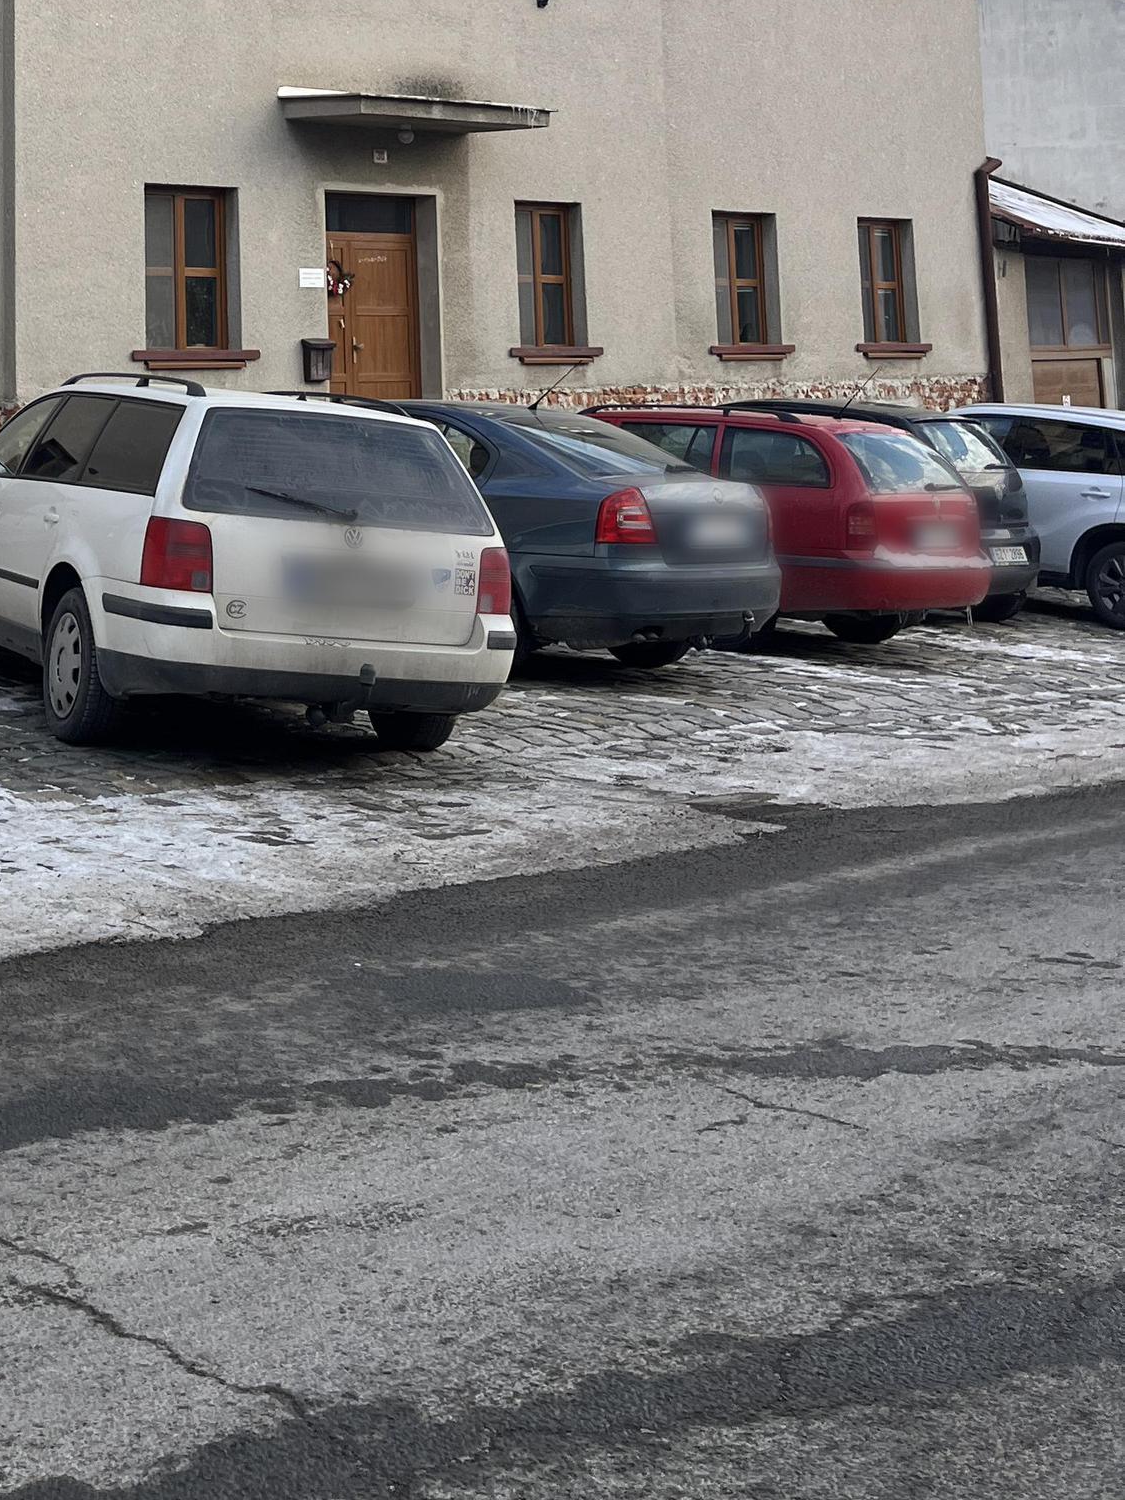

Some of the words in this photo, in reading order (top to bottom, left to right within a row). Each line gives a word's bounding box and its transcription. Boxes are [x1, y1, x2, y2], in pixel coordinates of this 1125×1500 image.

[455, 569, 475, 579] DON'T
[455, 586, 475, 595] DICK
[228, 604, 244, 615] CZ
